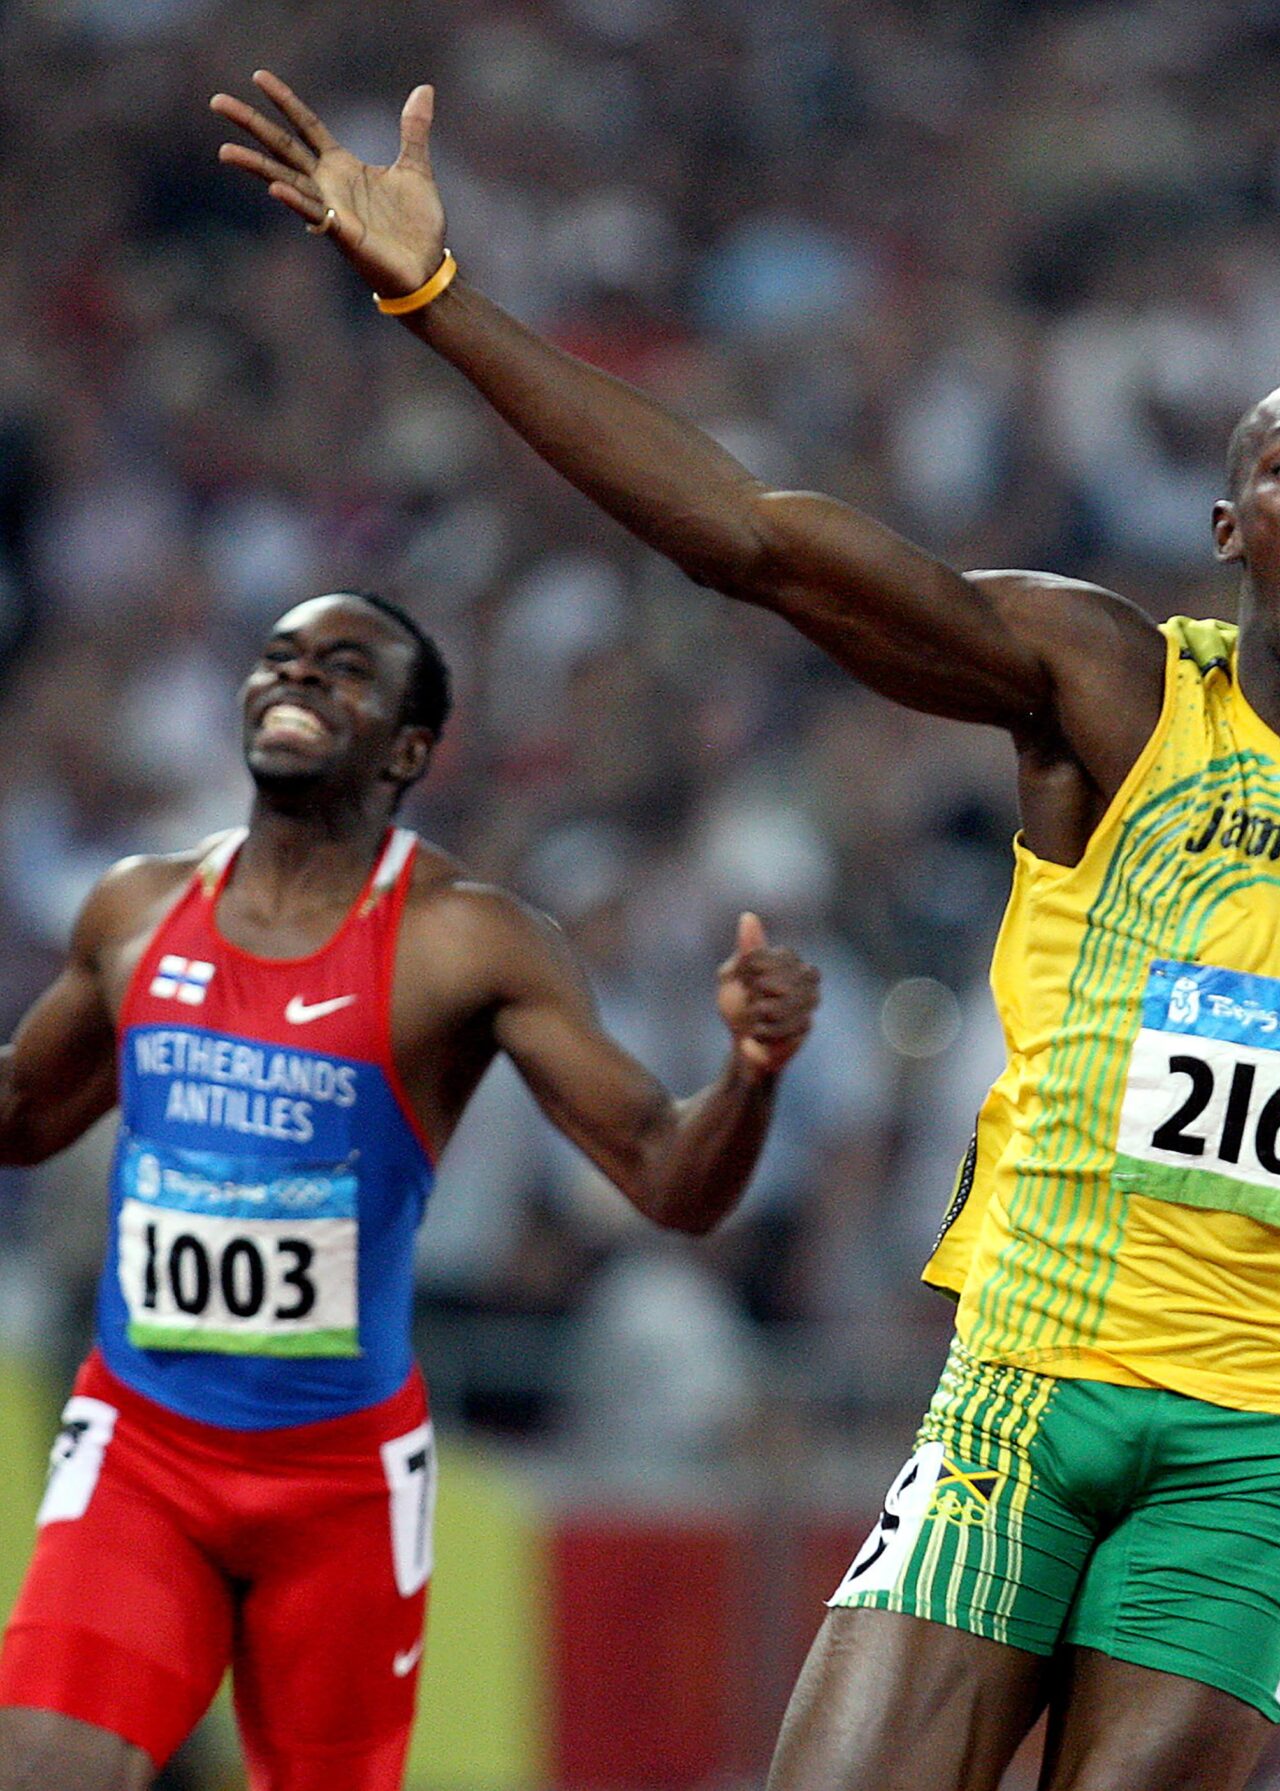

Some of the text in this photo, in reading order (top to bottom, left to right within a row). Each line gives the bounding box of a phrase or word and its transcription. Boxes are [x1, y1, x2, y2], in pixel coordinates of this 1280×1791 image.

[135, 1030, 357, 1108] NETHERLANDS
[166, 1081, 314, 1142] ANTILLES
[142, 1222, 317, 1320] 1003
